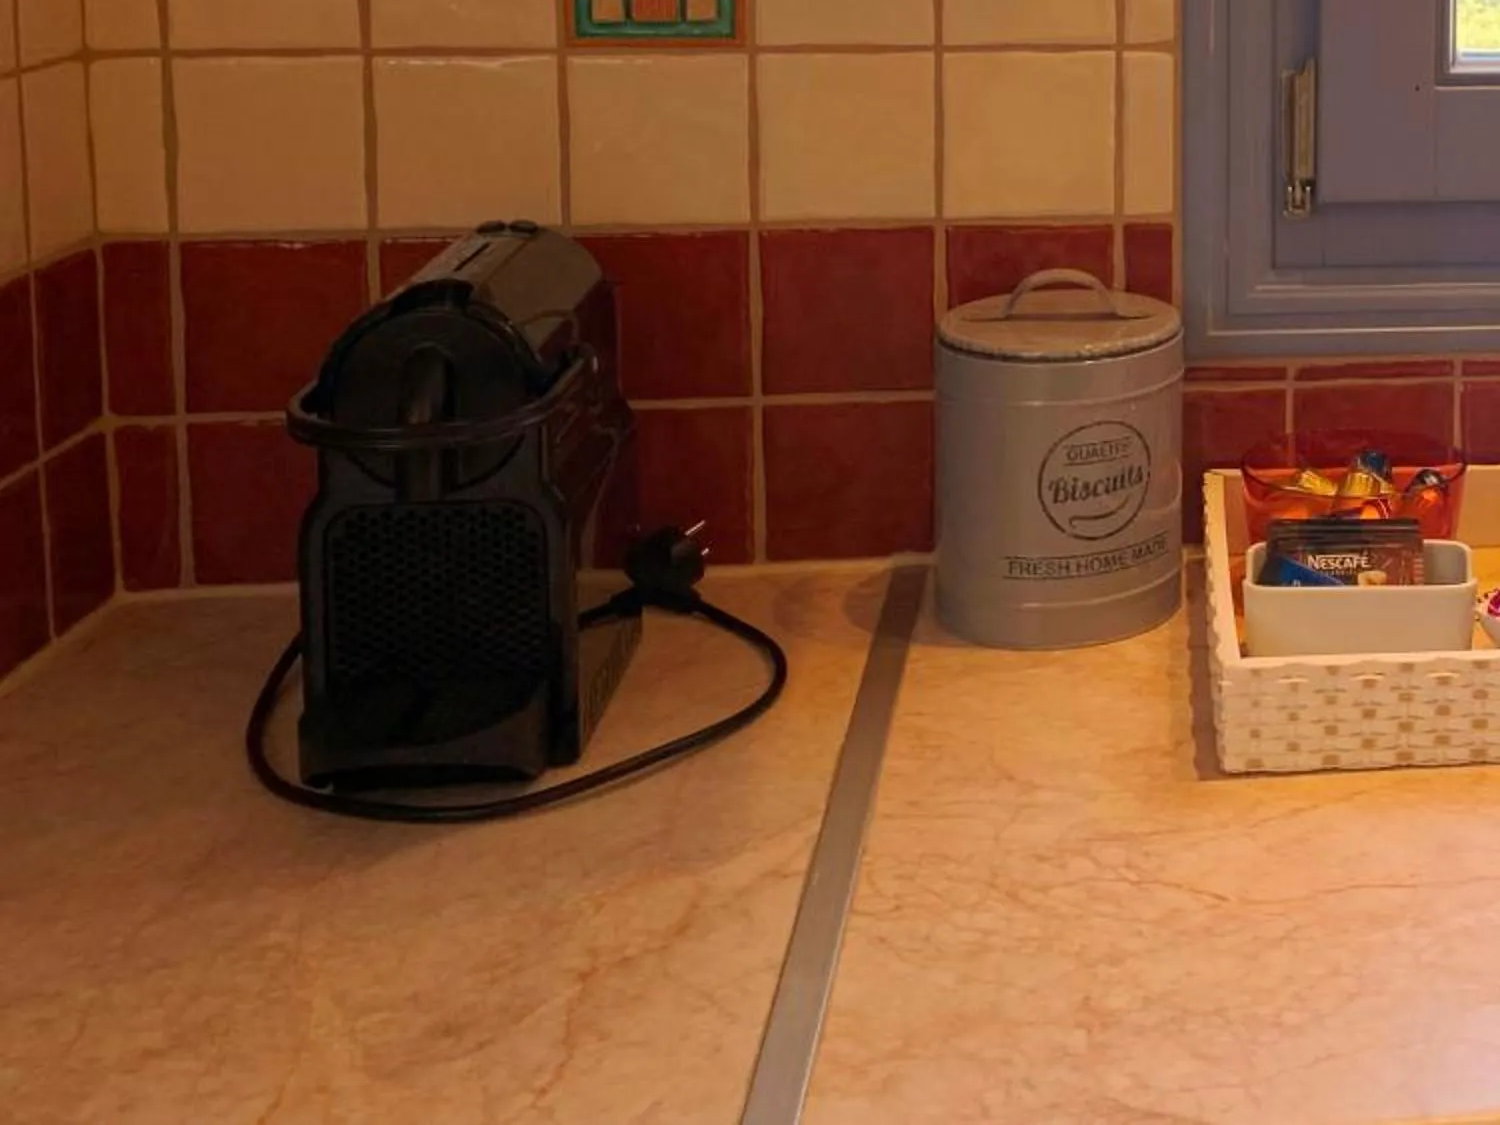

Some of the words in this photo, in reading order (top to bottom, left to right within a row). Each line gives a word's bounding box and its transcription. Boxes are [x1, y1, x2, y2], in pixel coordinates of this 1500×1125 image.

[1048, 464, 1144, 505] Biscuits
[1008, 560, 1071, 576] FRESH
[1075, 553, 1128, 573] HOME
